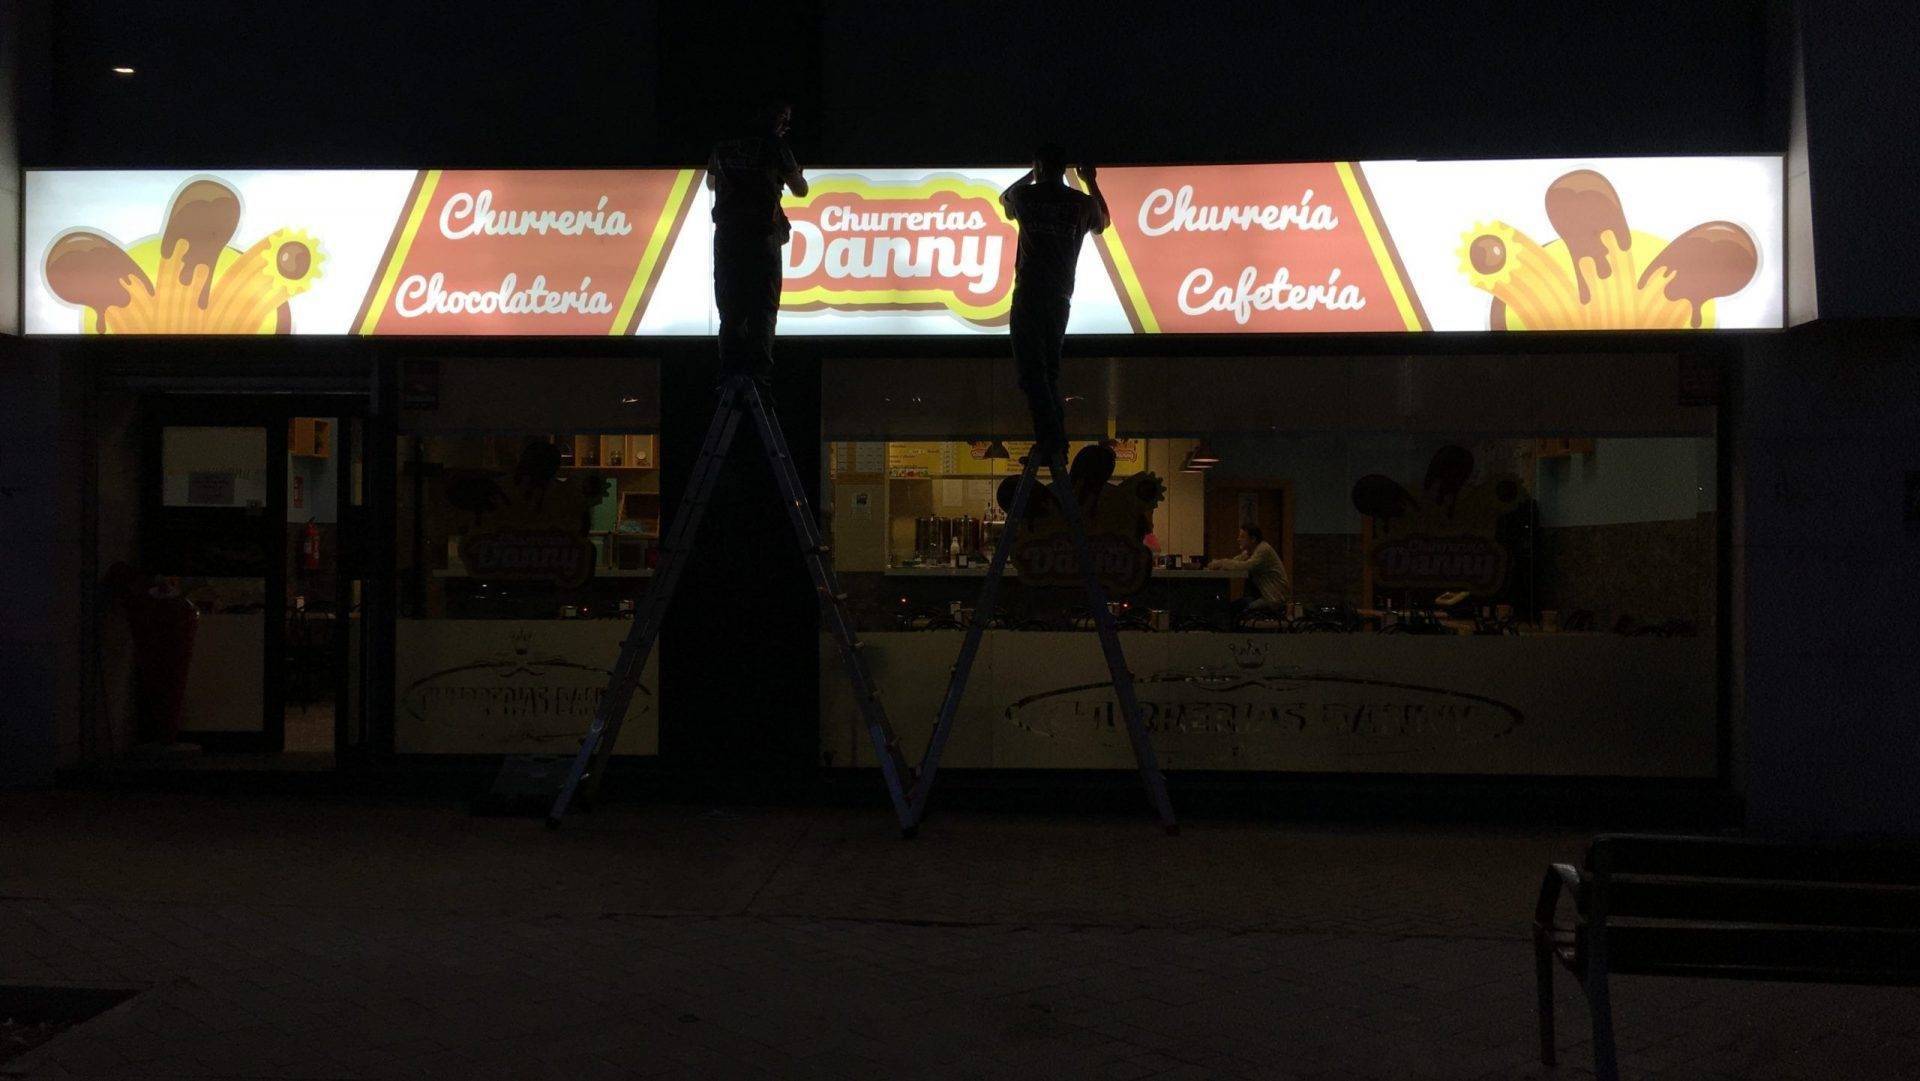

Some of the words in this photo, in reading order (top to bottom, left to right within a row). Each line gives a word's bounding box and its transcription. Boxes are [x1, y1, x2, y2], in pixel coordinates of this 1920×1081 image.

[439, 189, 632, 240] Churrería
[820, 204, 987, 232] Churrerías
[1138, 185, 1339, 237] Churrería
[781, 220, 1004, 294] Danny
[395, 272, 613, 318] Chocolatería
[1177, 266, 1366, 325] Cafetería
[480, 542, 584, 577] Danny
[1385, 548, 1497, 584] Danny
